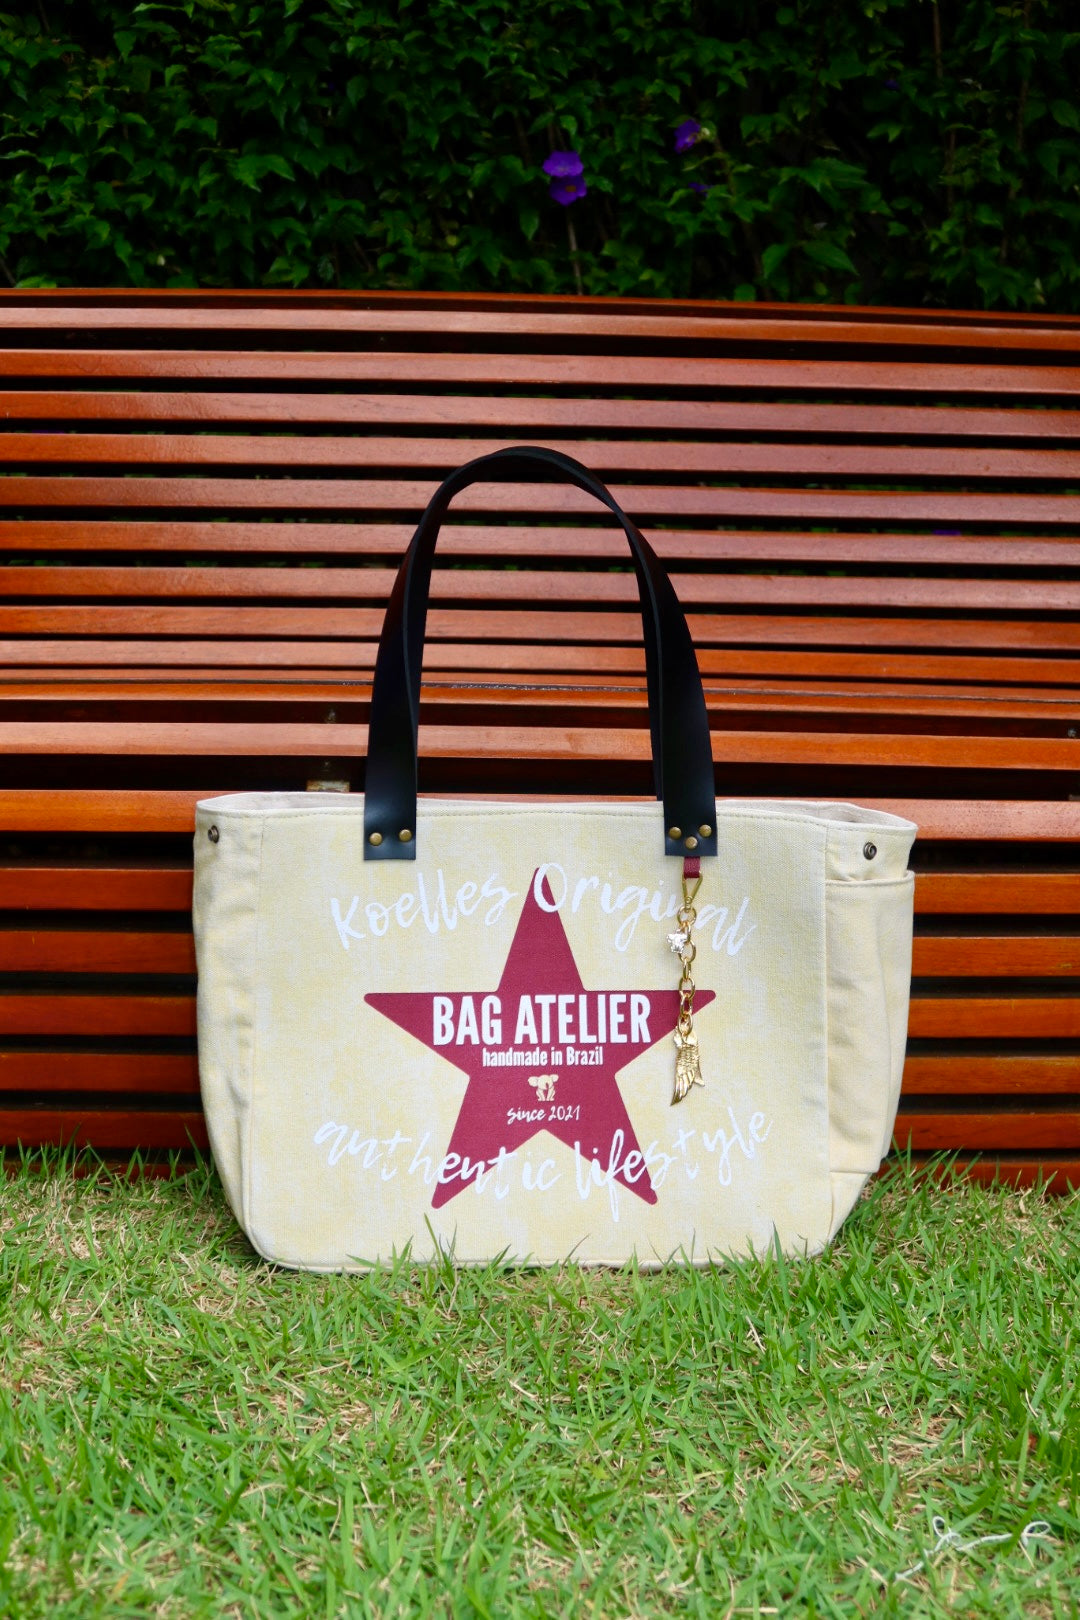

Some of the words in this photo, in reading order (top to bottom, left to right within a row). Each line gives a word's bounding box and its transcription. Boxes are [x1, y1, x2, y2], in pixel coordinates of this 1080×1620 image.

[330, 869, 518, 950] Koelles
[433, 996, 502, 1046] BAG
[515, 994, 651, 1045] ATELIER
[482, 1047, 548, 1067] handmade
[551, 1046, 563, 1066] in
[566, 1046, 604, 1066] Brazil
[507, 1107, 546, 1125] since
[548, 1105, 581, 1121] 2021
[314, 1121, 561, 1200] authentic
[574, 1106, 774, 1223] lifestyle
